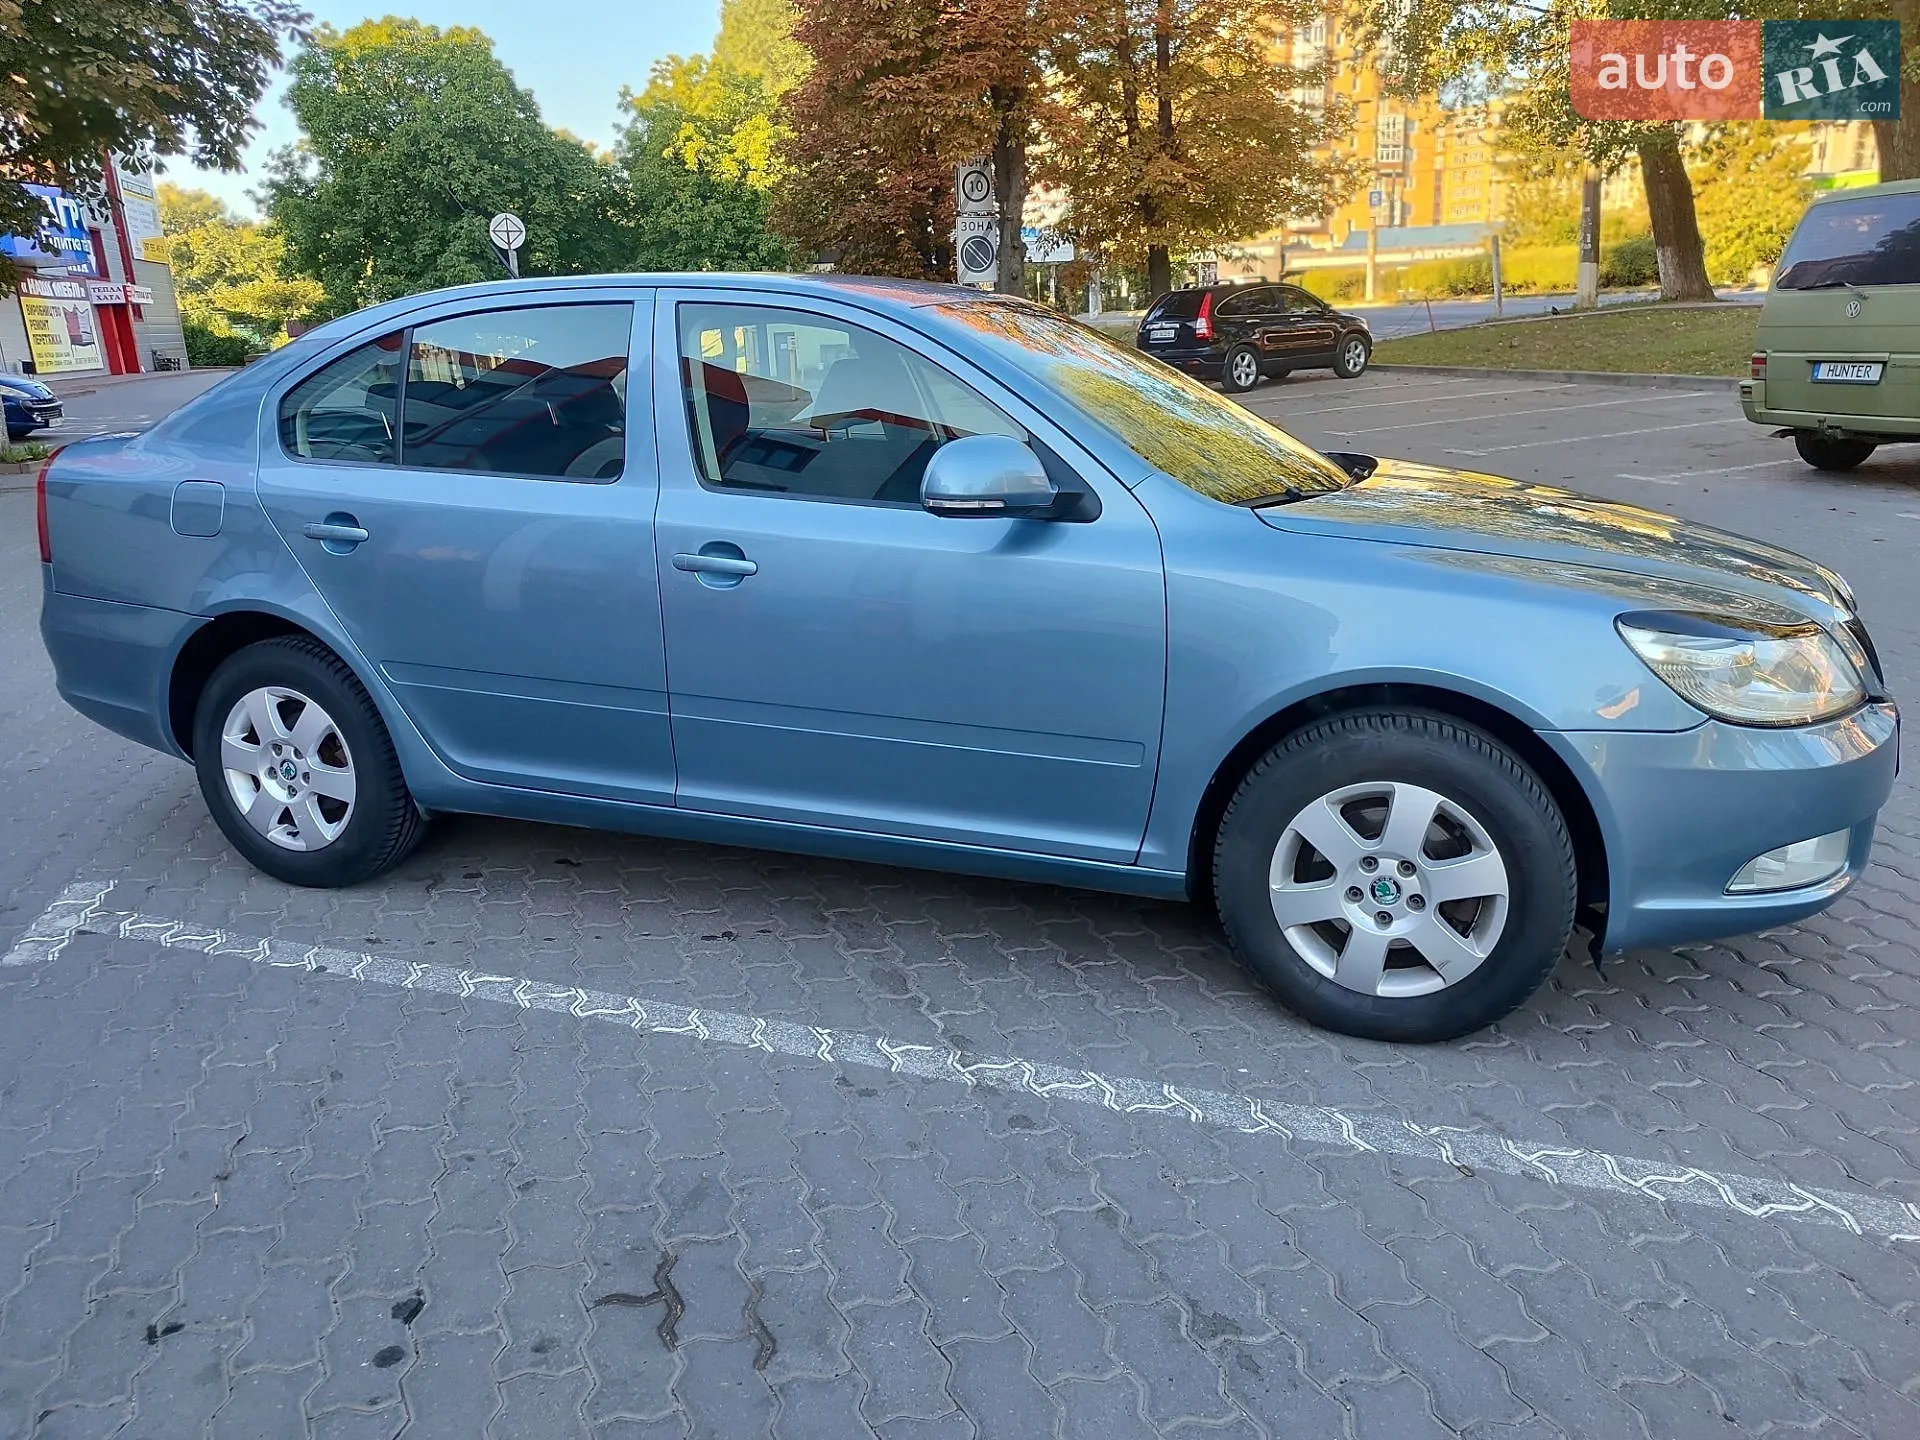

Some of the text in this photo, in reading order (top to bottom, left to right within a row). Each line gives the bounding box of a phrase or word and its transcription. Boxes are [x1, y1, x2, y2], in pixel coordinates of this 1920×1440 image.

[969, 180, 984, 193] 10
[960, 221, 993, 232] ЗОНА
[1827, 364, 1872, 378] HUNTER
